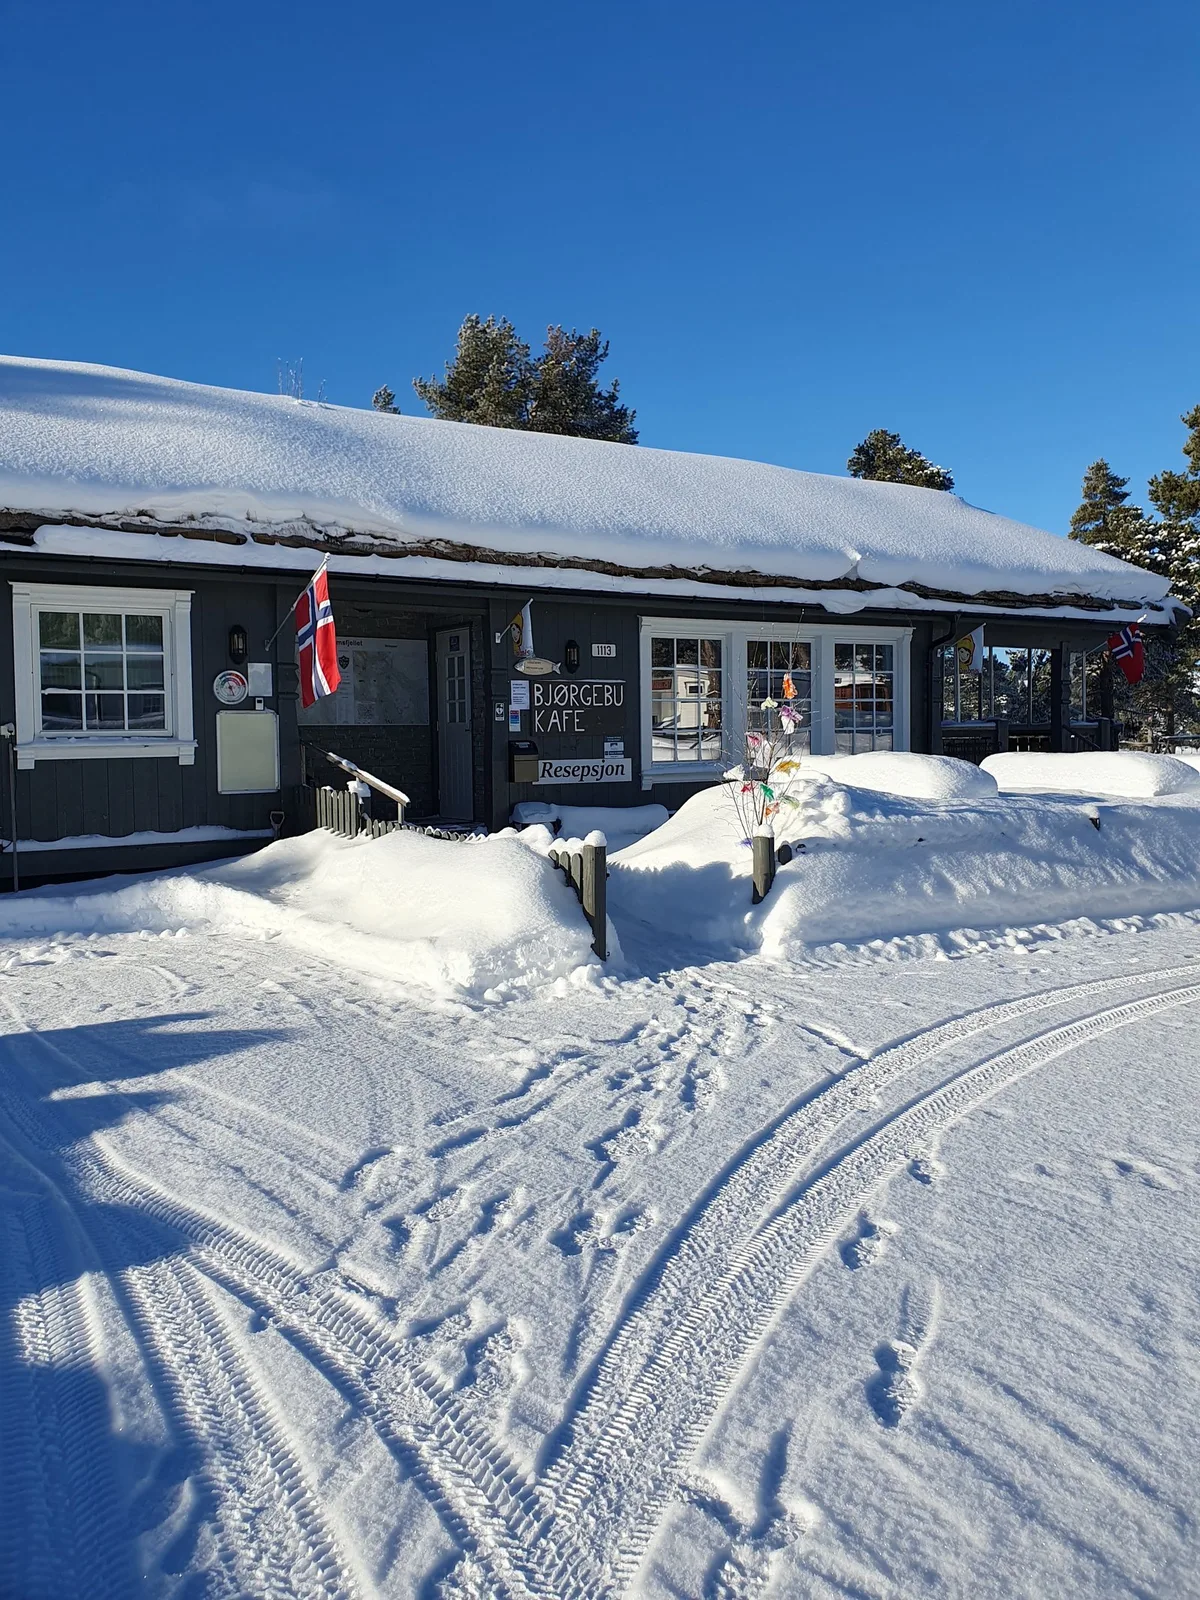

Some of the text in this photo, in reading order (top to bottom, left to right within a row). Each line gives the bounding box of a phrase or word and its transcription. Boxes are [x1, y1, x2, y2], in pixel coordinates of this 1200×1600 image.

[597, 645, 612, 656] 1113
[534, 684, 624, 707] BJØRGEBU
[534, 710, 585, 732] KAFE
[541, 759, 625, 781] Resepsjon
